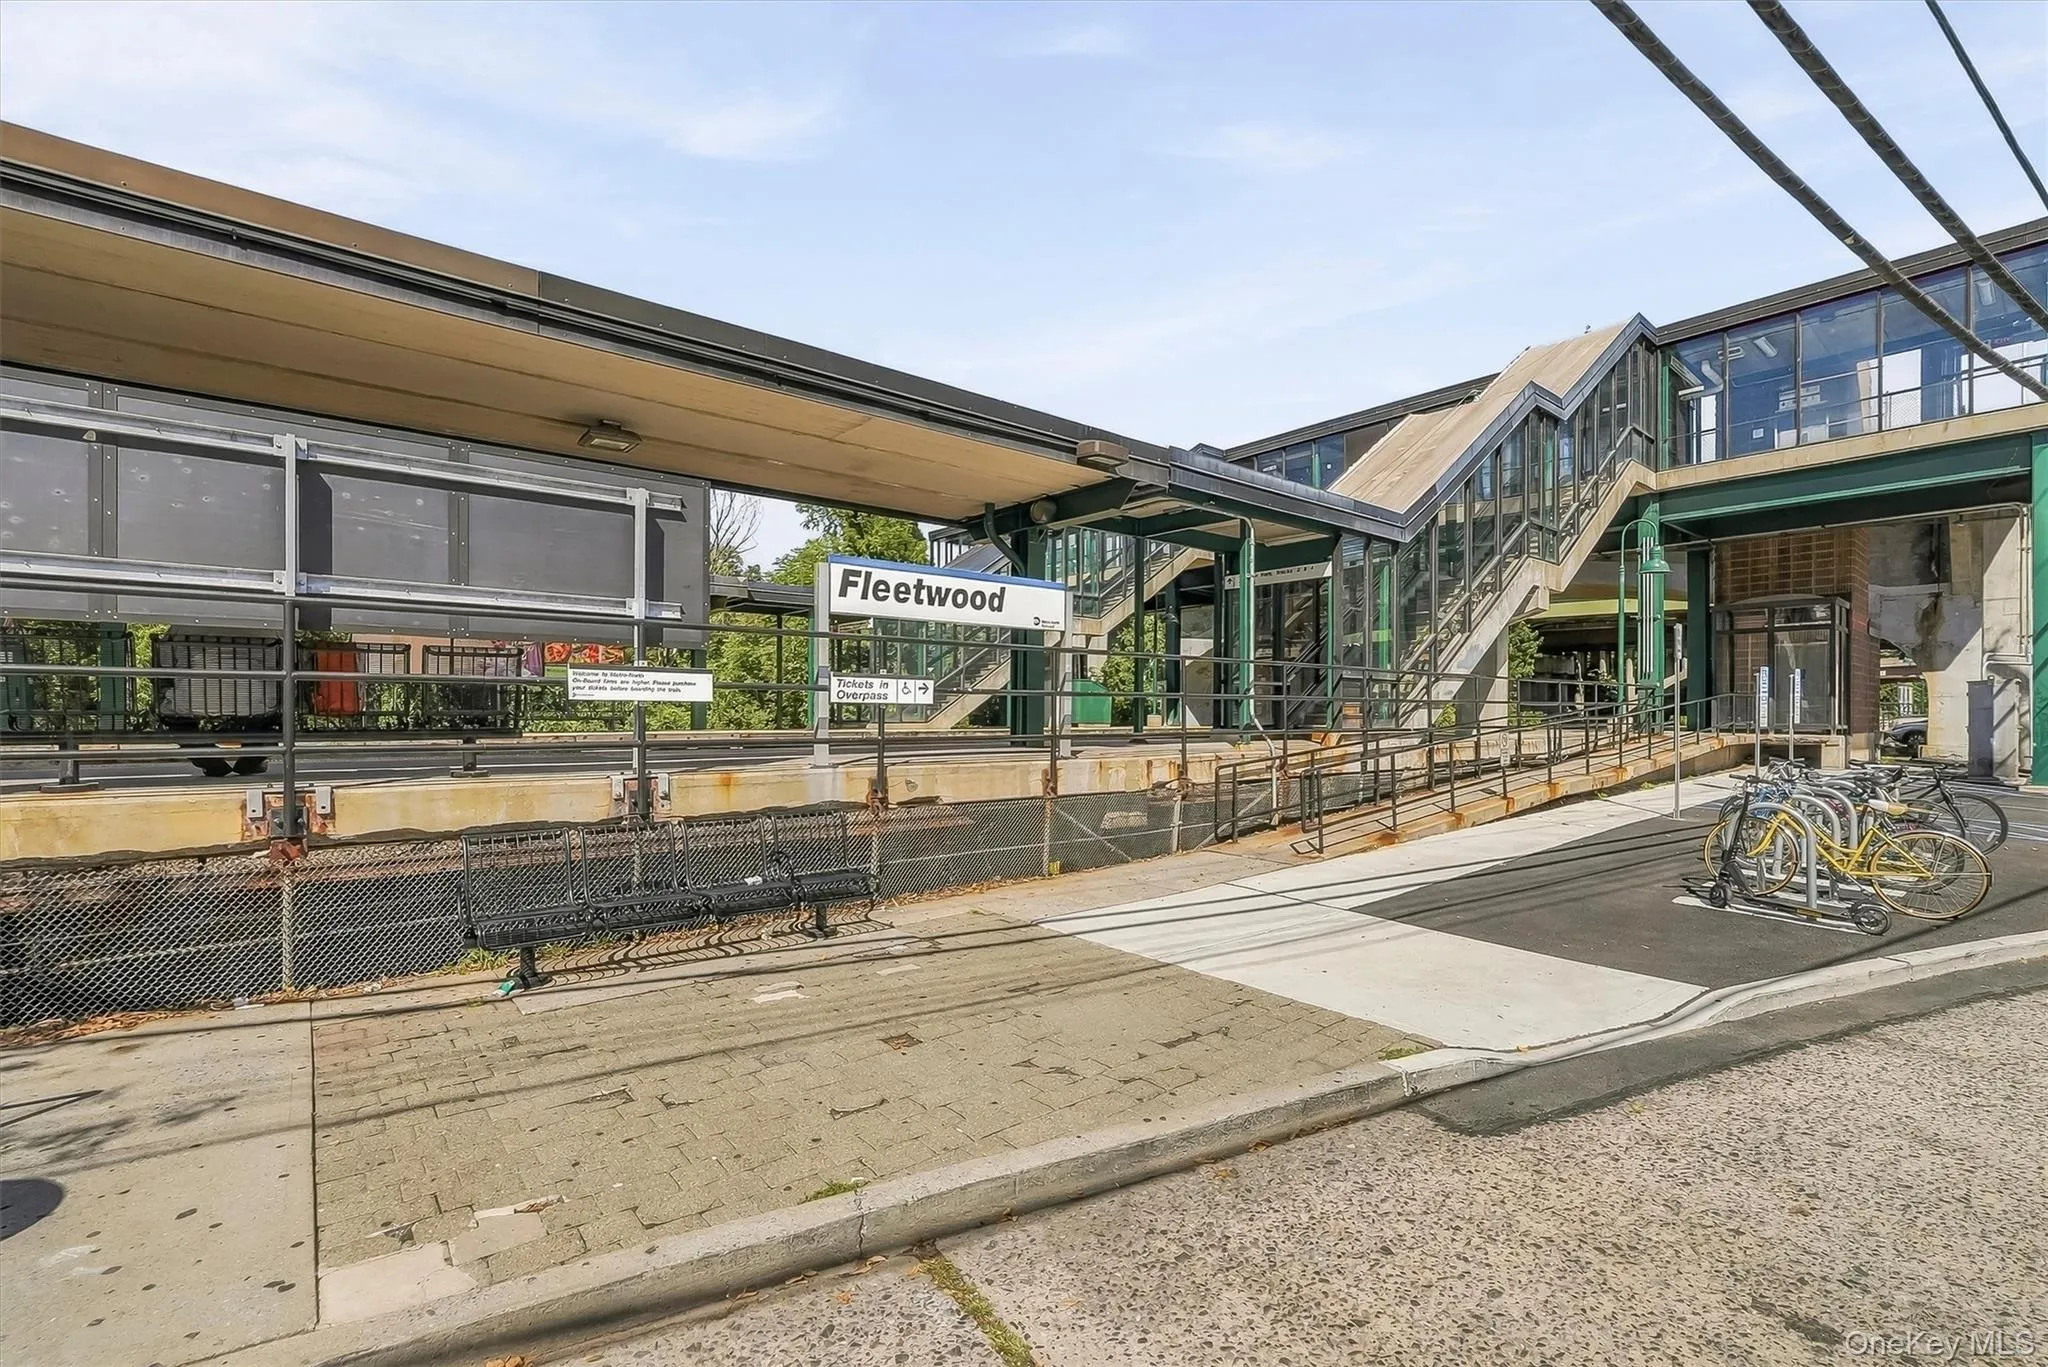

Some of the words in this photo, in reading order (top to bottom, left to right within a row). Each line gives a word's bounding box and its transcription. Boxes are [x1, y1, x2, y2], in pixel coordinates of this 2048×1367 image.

[838, 567, 1006, 612] Fleetwood
[837, 678, 874, 689] Tickets
[879, 679, 889, 689] in
[836, 689, 889, 702] Overpass
